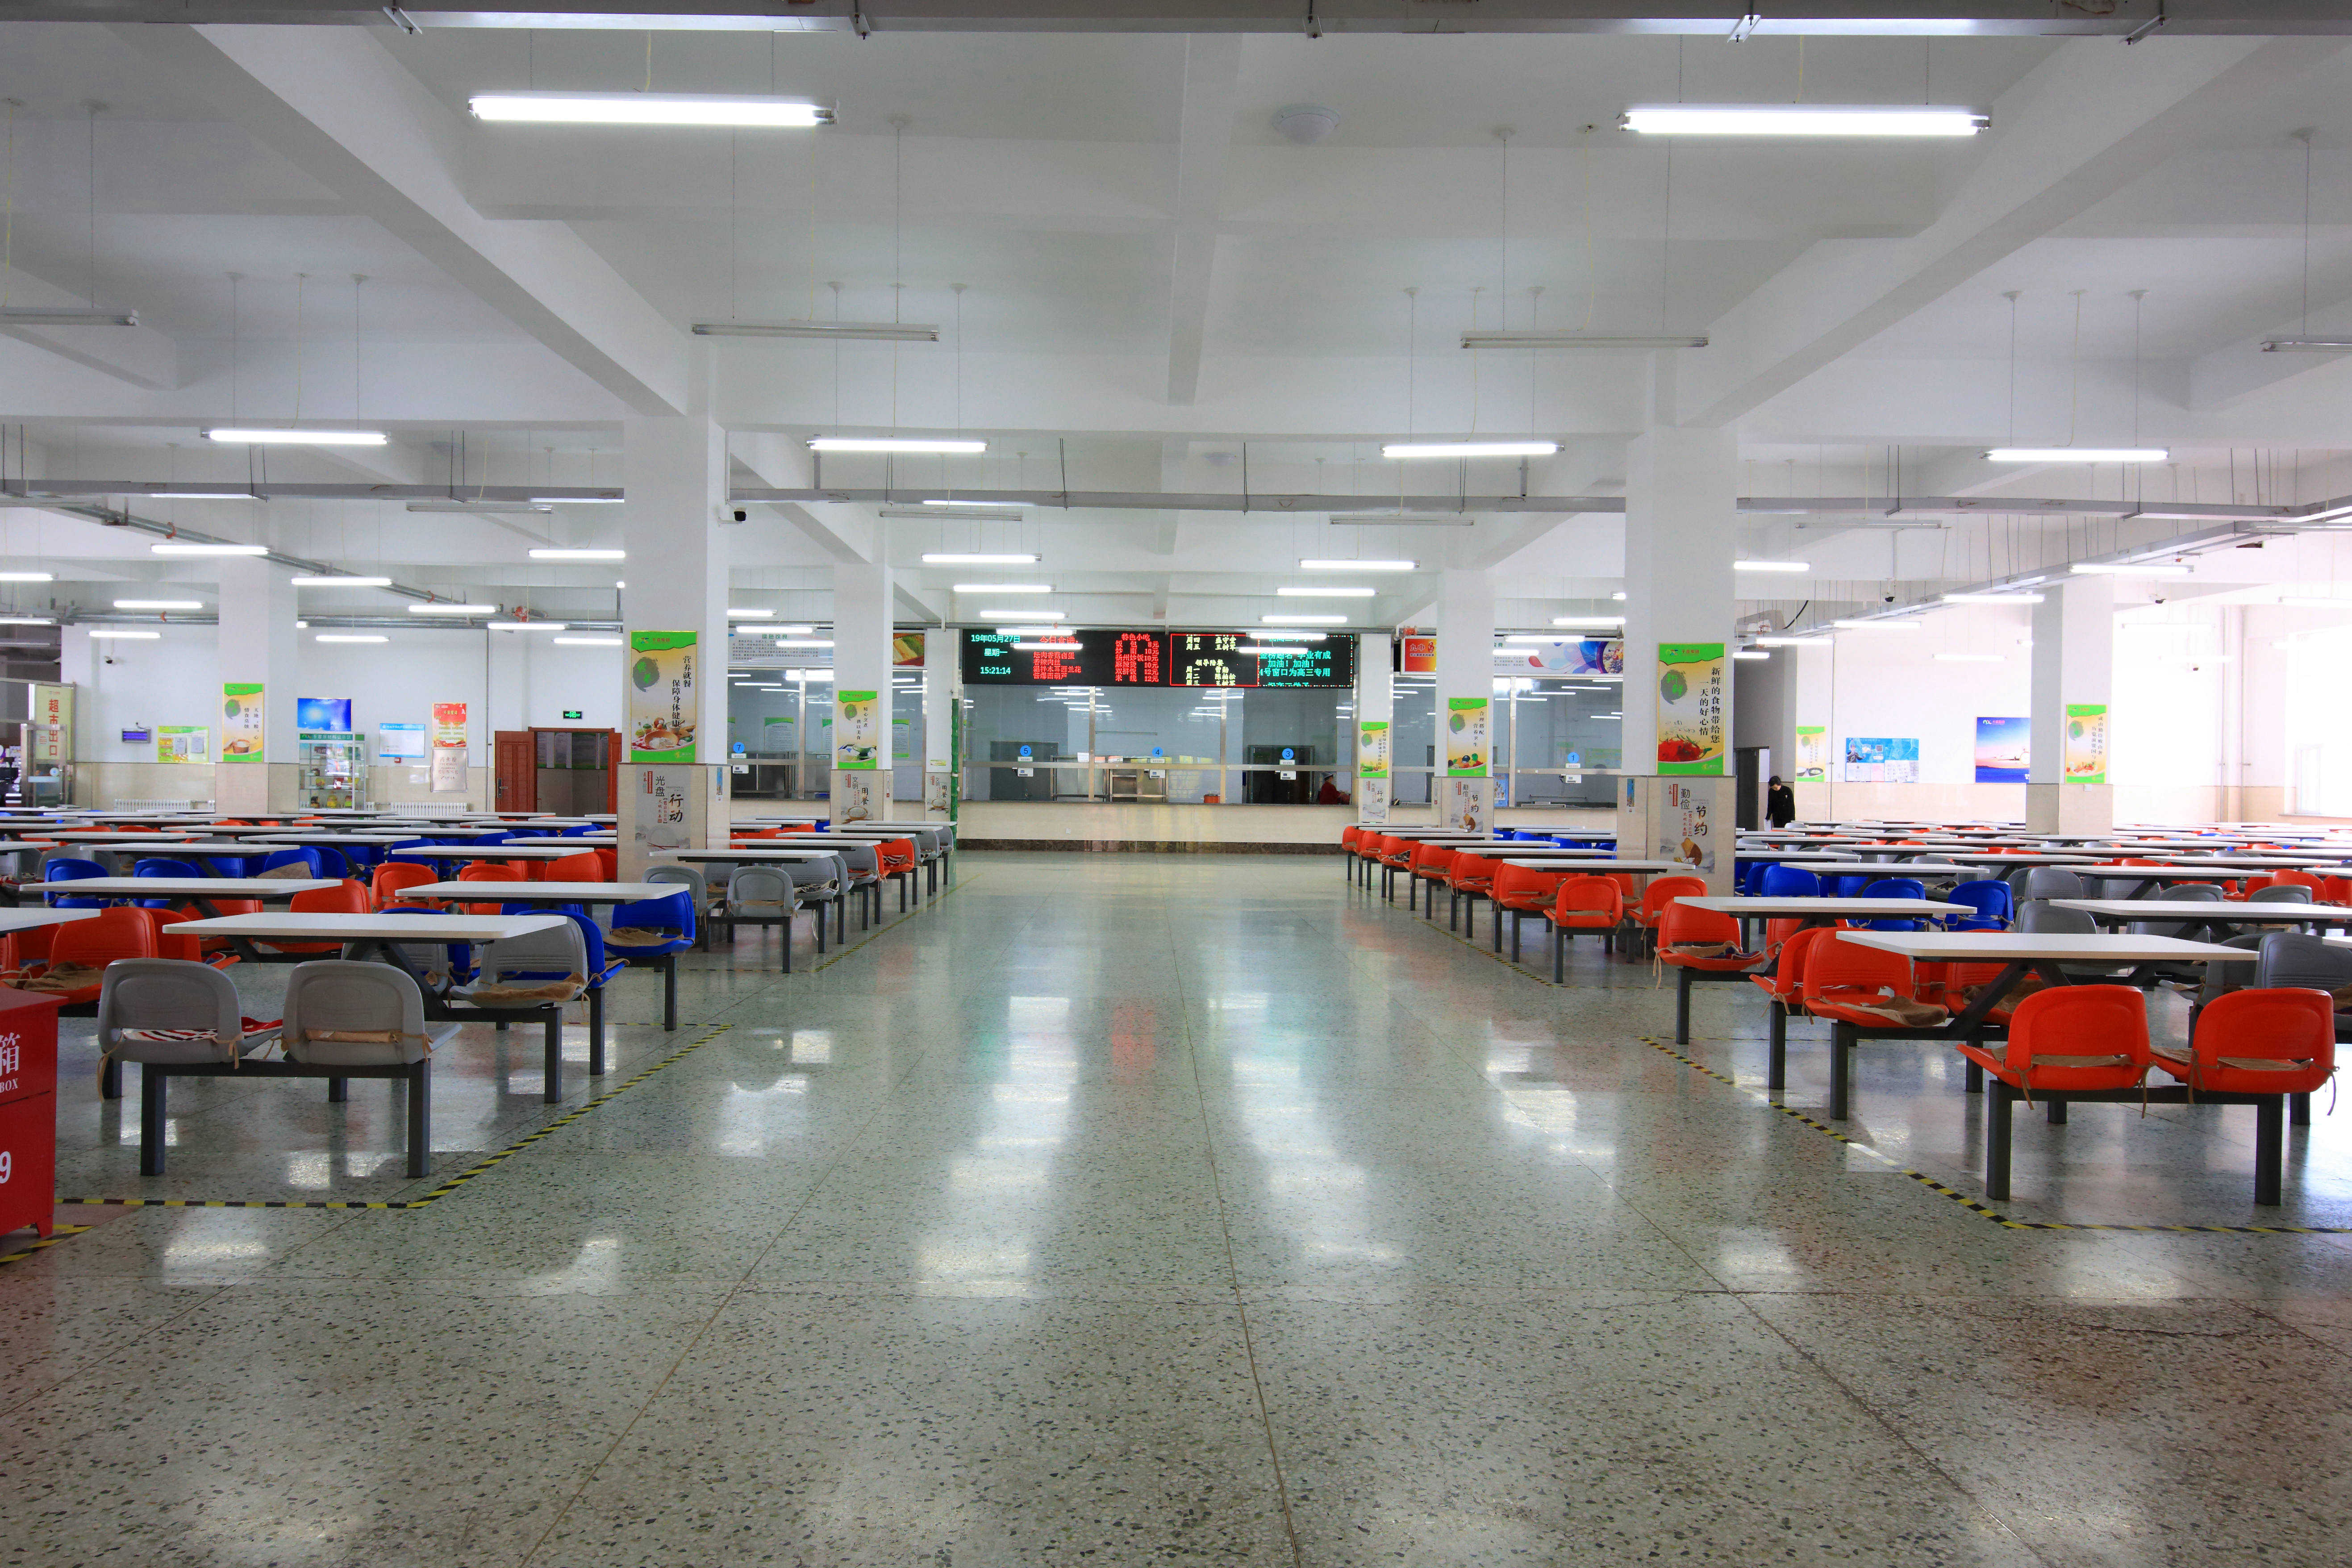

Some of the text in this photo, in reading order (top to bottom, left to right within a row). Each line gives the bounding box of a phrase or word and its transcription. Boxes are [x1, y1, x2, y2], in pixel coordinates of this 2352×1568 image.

[971, 634, 1020, 643] 19年05月27日
[984, 648, 1008, 656] 星期一
[980, 667, 1011, 675] 15:21:14
[1259, 668, 1330, 677] 4号窗口为高三专用
[672, 679, 681, 727] 保障身体健康
[1699, 681, 1709, 736] 一天的好心情
[1711, 667, 1721, 744] 新鲜的食物带给您
[49, 699, 59, 756] 超市出口
[655, 776, 665, 797] 光盘
[669, 793, 684, 822] 行动
[1470, 795, 1479, 813] 节约
[1680, 788, 1690, 809] 勤俭
[1694, 805, 1708, 836] 节约
[0, 1078, 18, 1093] BOX
